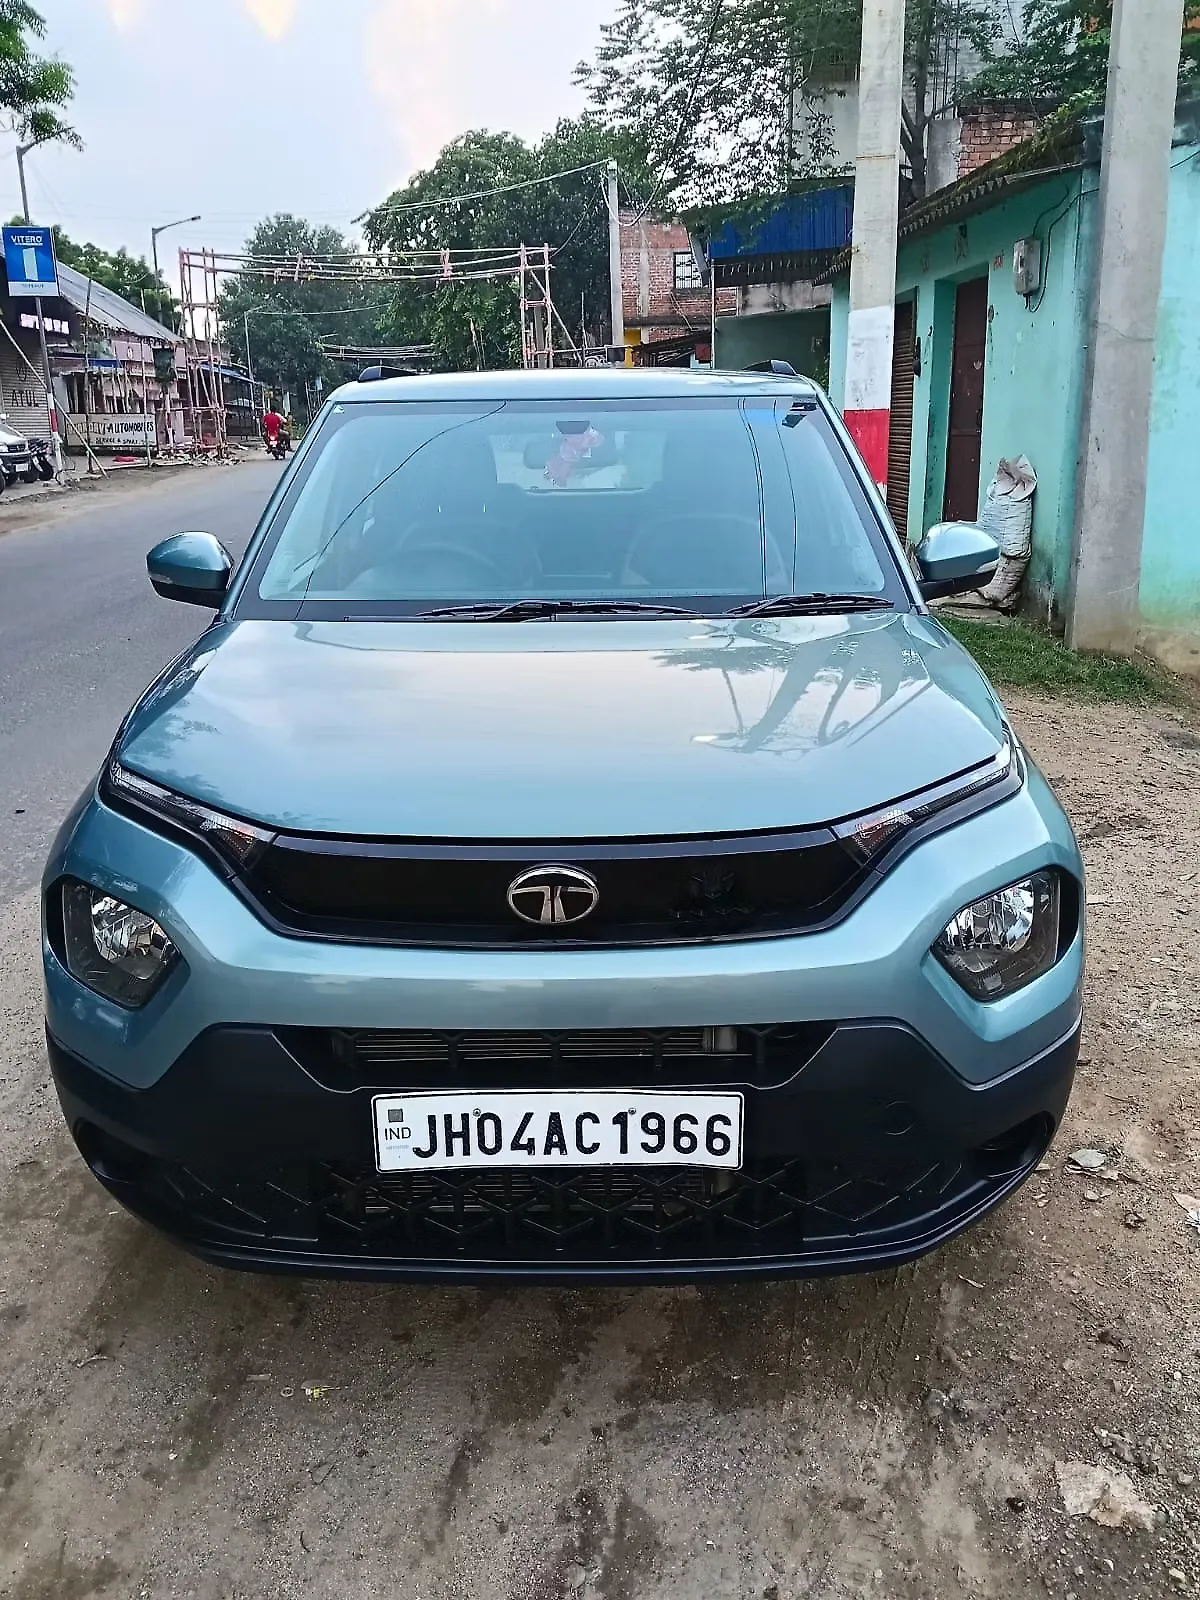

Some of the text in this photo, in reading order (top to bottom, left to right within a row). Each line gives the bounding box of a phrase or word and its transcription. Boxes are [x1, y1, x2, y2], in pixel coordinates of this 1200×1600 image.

[10, 235, 43, 243] VITERO
[384, 1127, 411, 1140] IND
[412, 1111, 731, 1159] JH04AC1966
